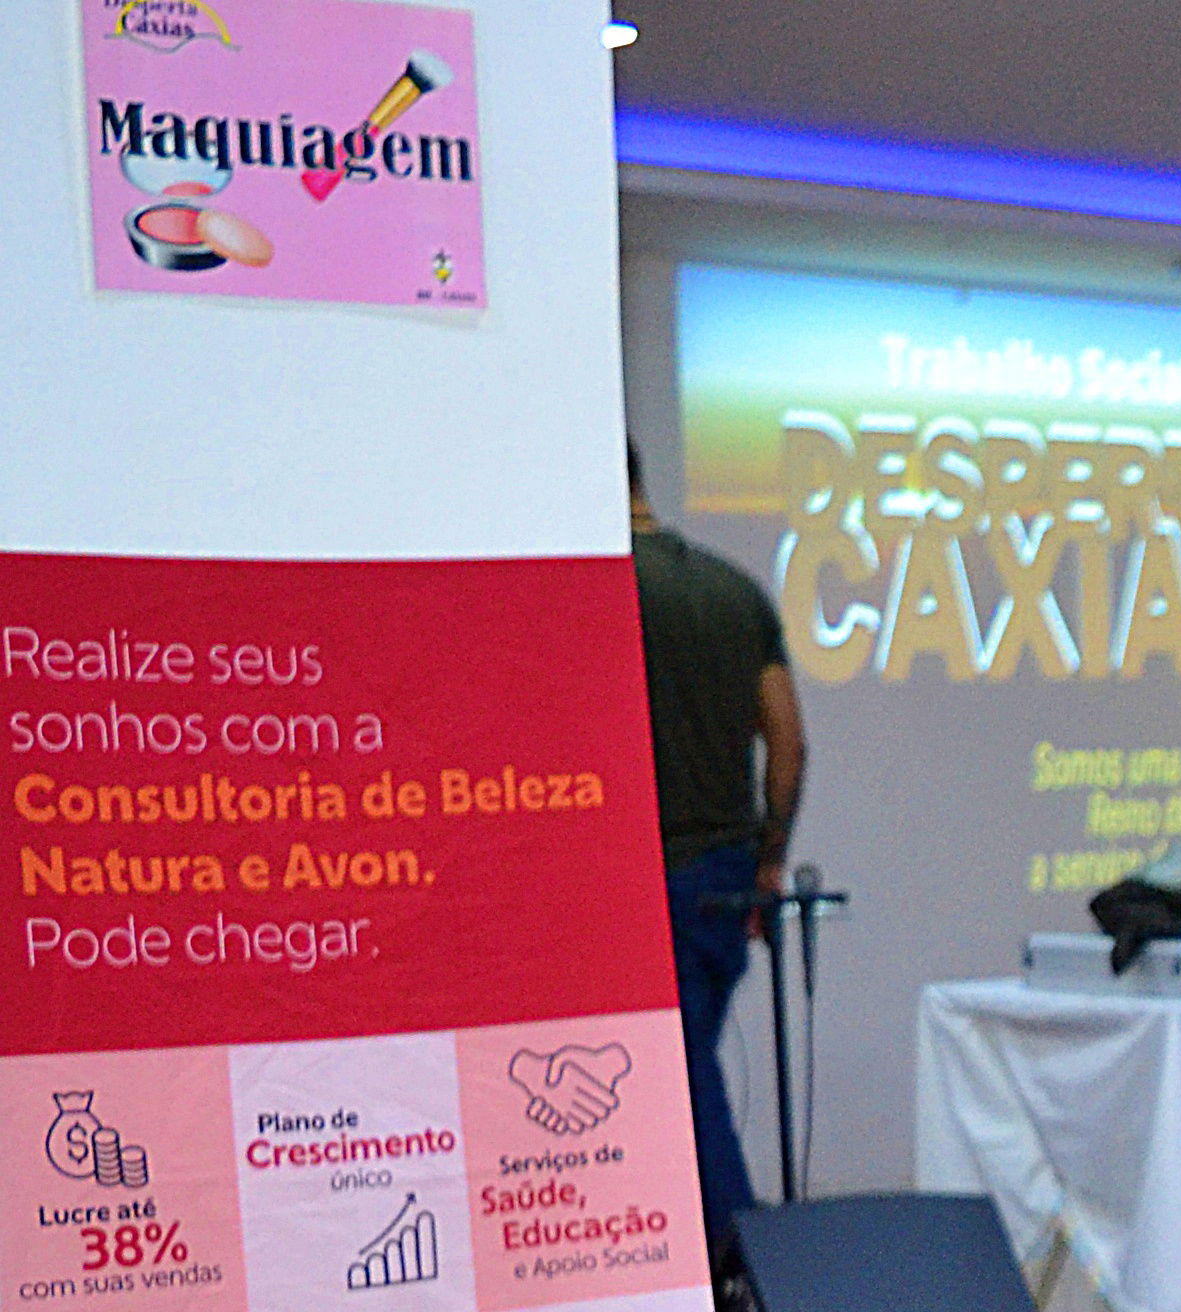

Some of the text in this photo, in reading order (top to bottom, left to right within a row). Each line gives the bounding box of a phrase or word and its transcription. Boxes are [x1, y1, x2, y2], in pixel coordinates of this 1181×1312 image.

[121, 12, 195, 39] Caxias
[99, 98, 474, 182] Maquiagem
[880, 334, 1073, 399] Trabalho
[2, 626, 323, 686] Realize seus
[10, 700, 385, 754] sonhos com a
[13, 764, 604, 823] Consultoria de Beleza
[20, 842, 436, 896] Natura e Avon.
[26, 911, 380, 971] Pode chegar.
[257, 1108, 358, 1133] Plano de
[246, 1128, 456, 1168] Crescimento
[500, 1144, 624, 1176] Serviços de
[330, 1167, 393, 1192] único
[481, 1180, 587, 1215] Saúde,
[39, 1197, 157, 1227] Lucre até
[503, 1206, 668, 1250] Educação
[80, 1220, 188, 1271] 38%
[514, 1242, 669, 1279] e Apoio Social
[19, 1263, 223, 1300] com suas vendas
